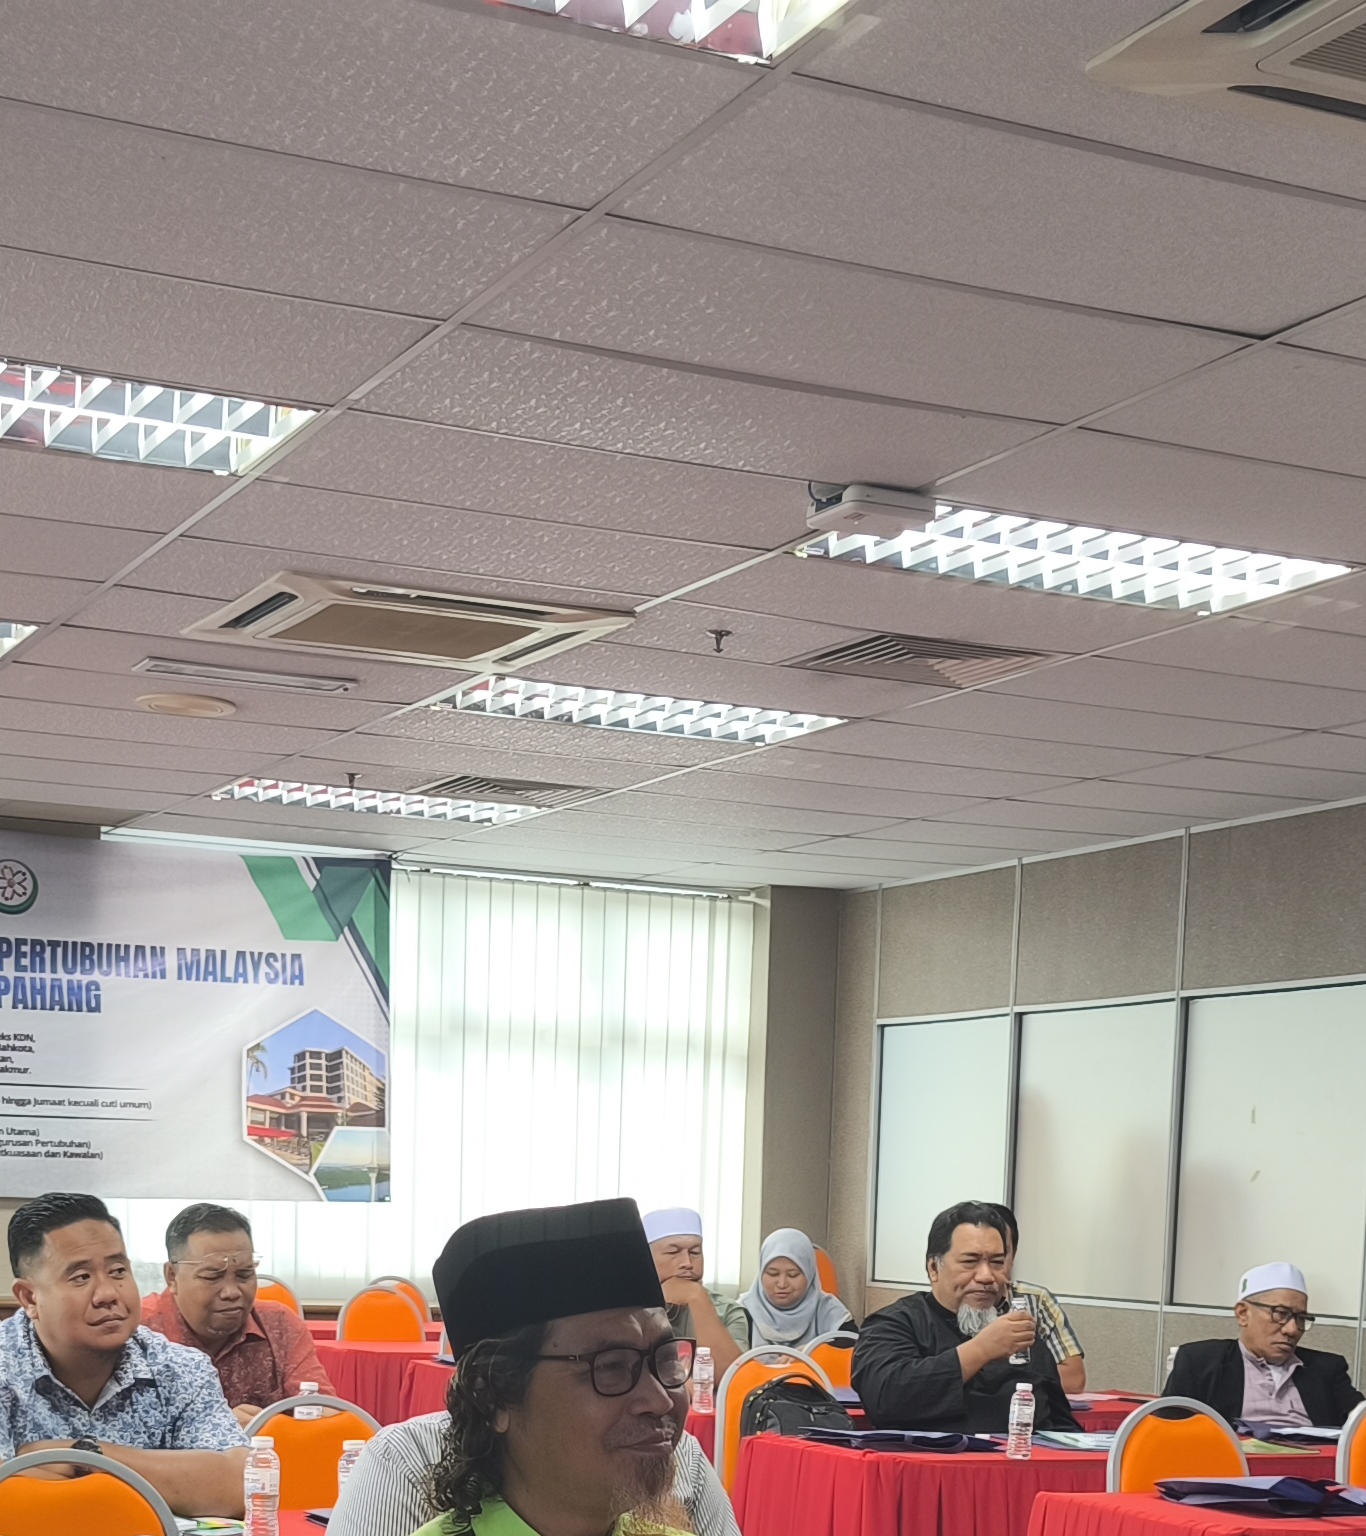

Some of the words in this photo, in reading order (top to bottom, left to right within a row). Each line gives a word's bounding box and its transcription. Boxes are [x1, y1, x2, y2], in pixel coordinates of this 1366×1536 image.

[176, 947, 305, 986] MALAYSIA
[13, 1033, 36, 1043] KDN,
[2, 1096, 31, 1107] hingga
[68, 1098, 99, 1108] kecuali
[101, 1099, 117, 1108] cuti
[119, 1100, 152, 1110] umum)
[6, 1127, 40, 1137] Utama)
[35, 1139, 91, 1149] Pertubuhan)
[44, 1150, 61, 1159] dan
[63, 1151, 103, 1160] Kawalan)
